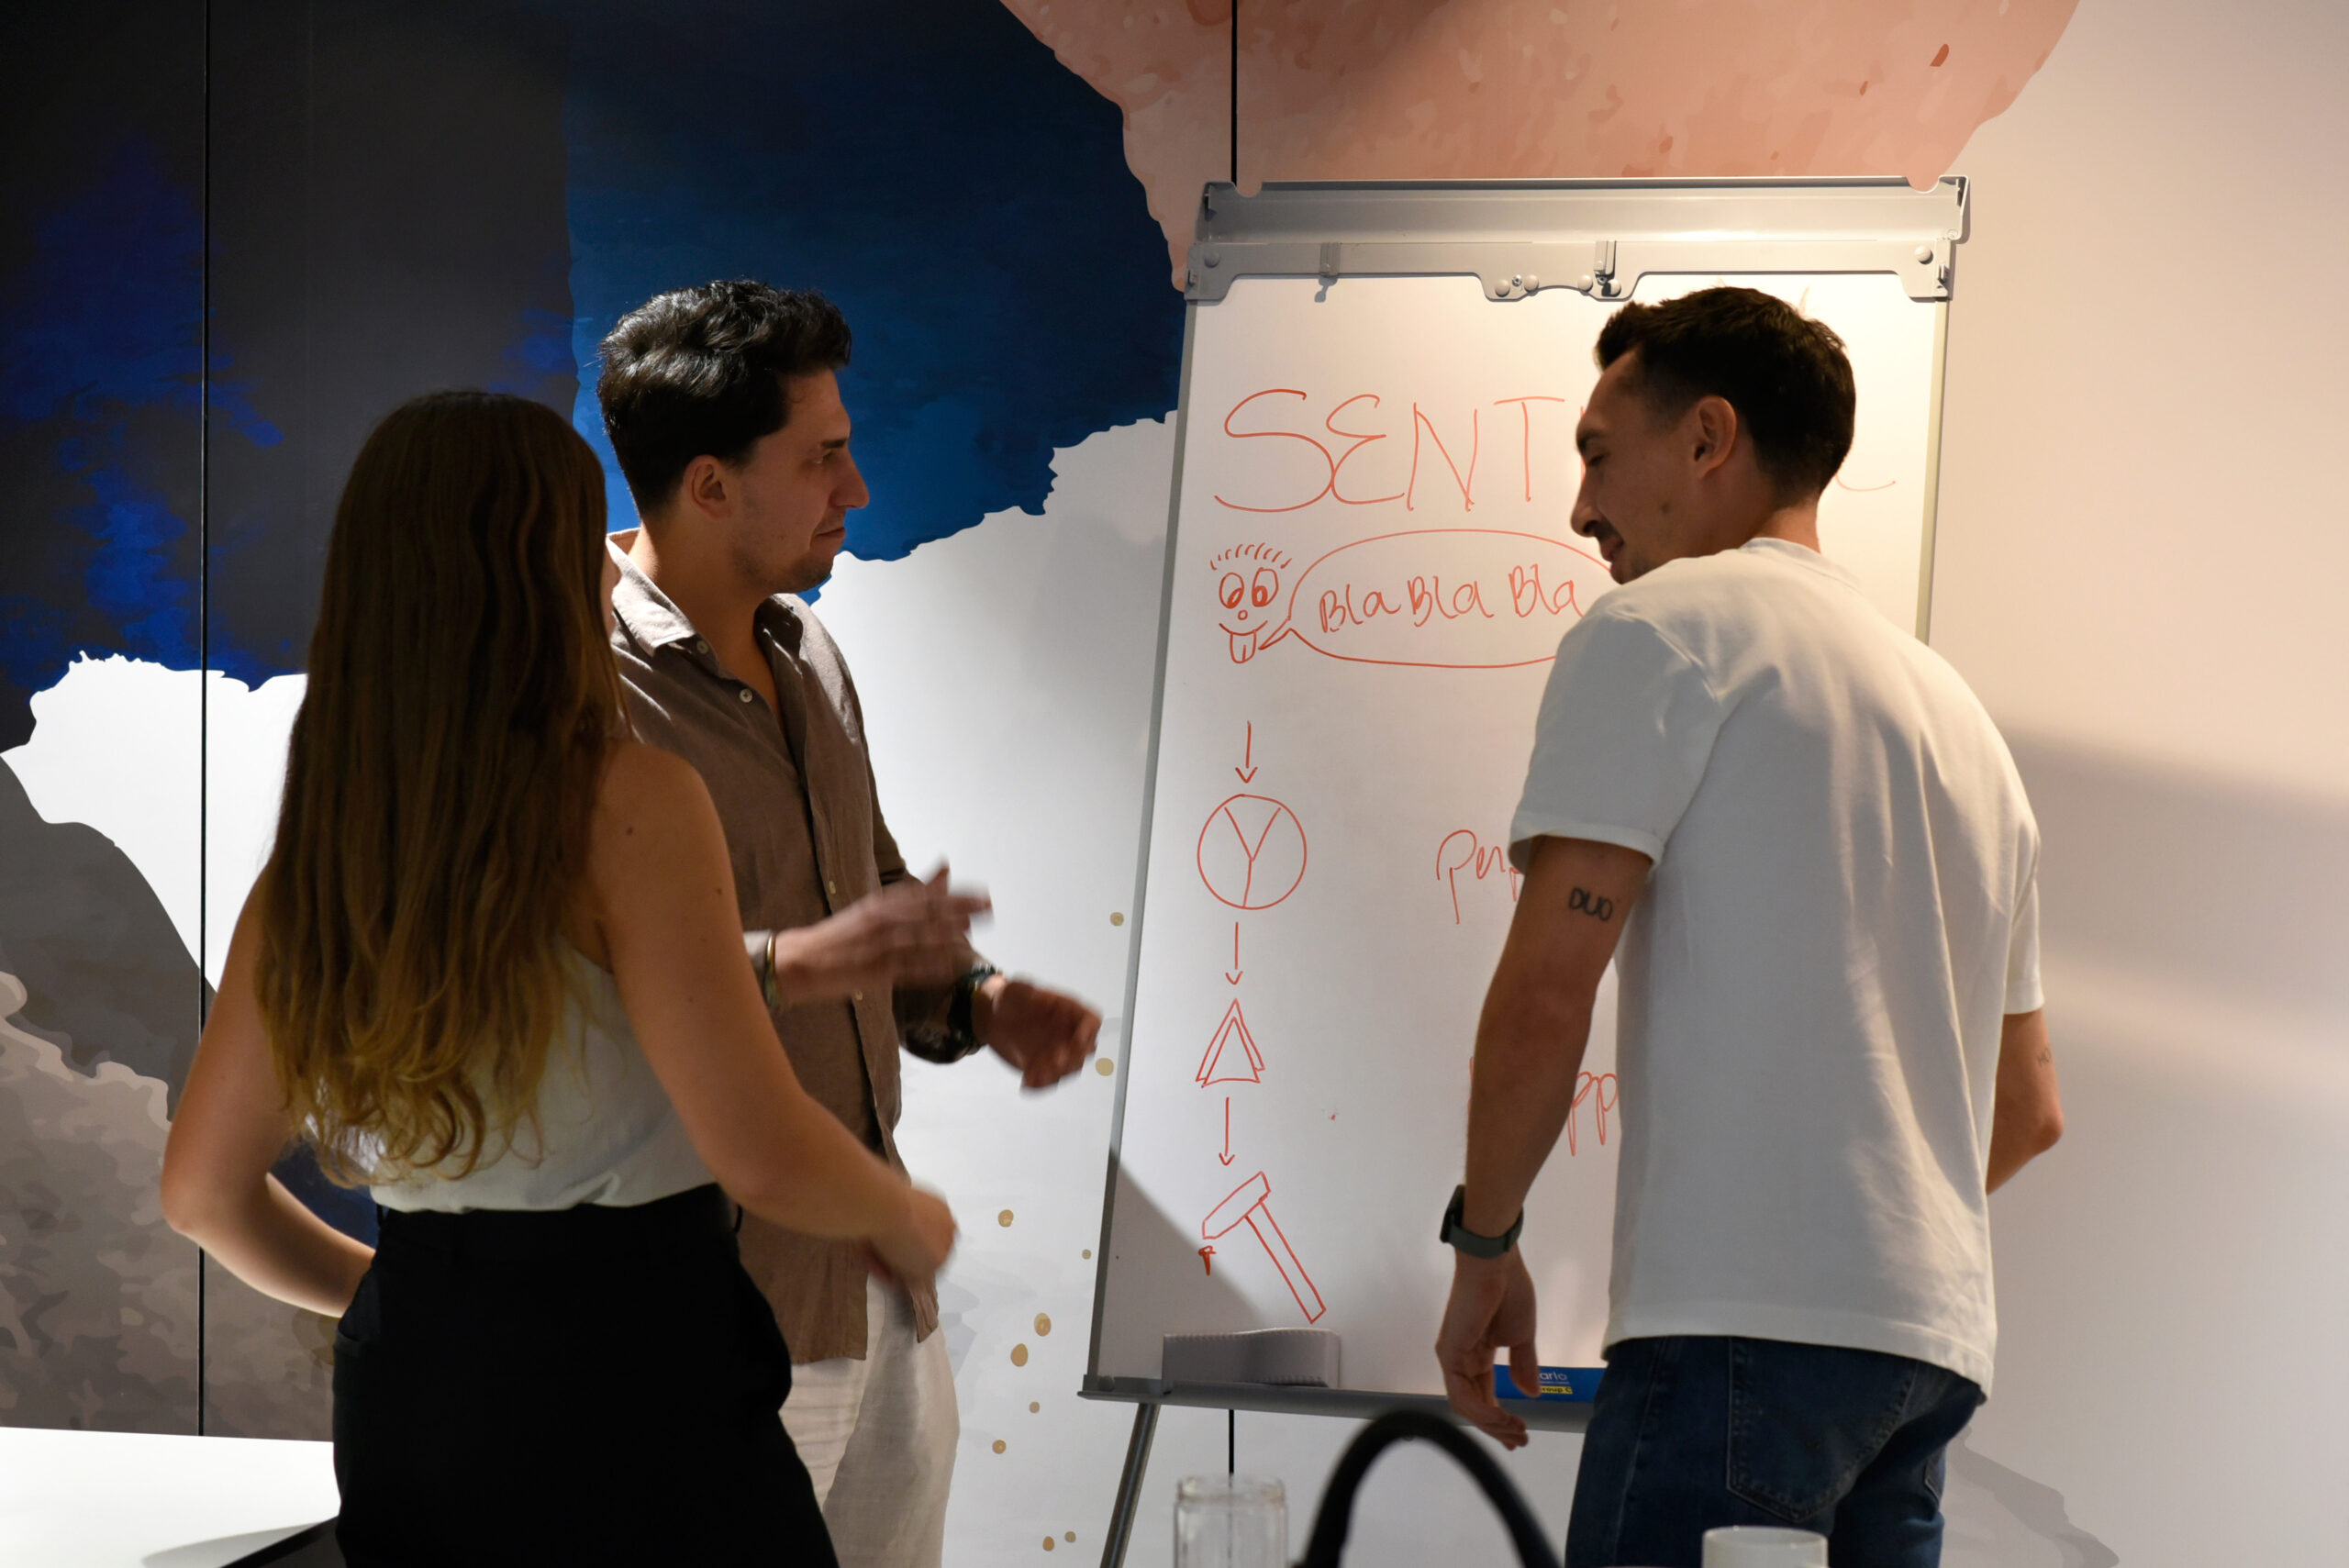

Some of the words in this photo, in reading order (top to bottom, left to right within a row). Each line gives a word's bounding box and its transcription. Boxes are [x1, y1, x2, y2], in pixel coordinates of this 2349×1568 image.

[1214, 387, 1588, 514] SENT
[1319, 583, 1402, 633] Bla
[1407, 574, 1495, 628] Bla
[1508, 562, 1585, 618] Bla
[1568, 887, 1613, 922] DUO
